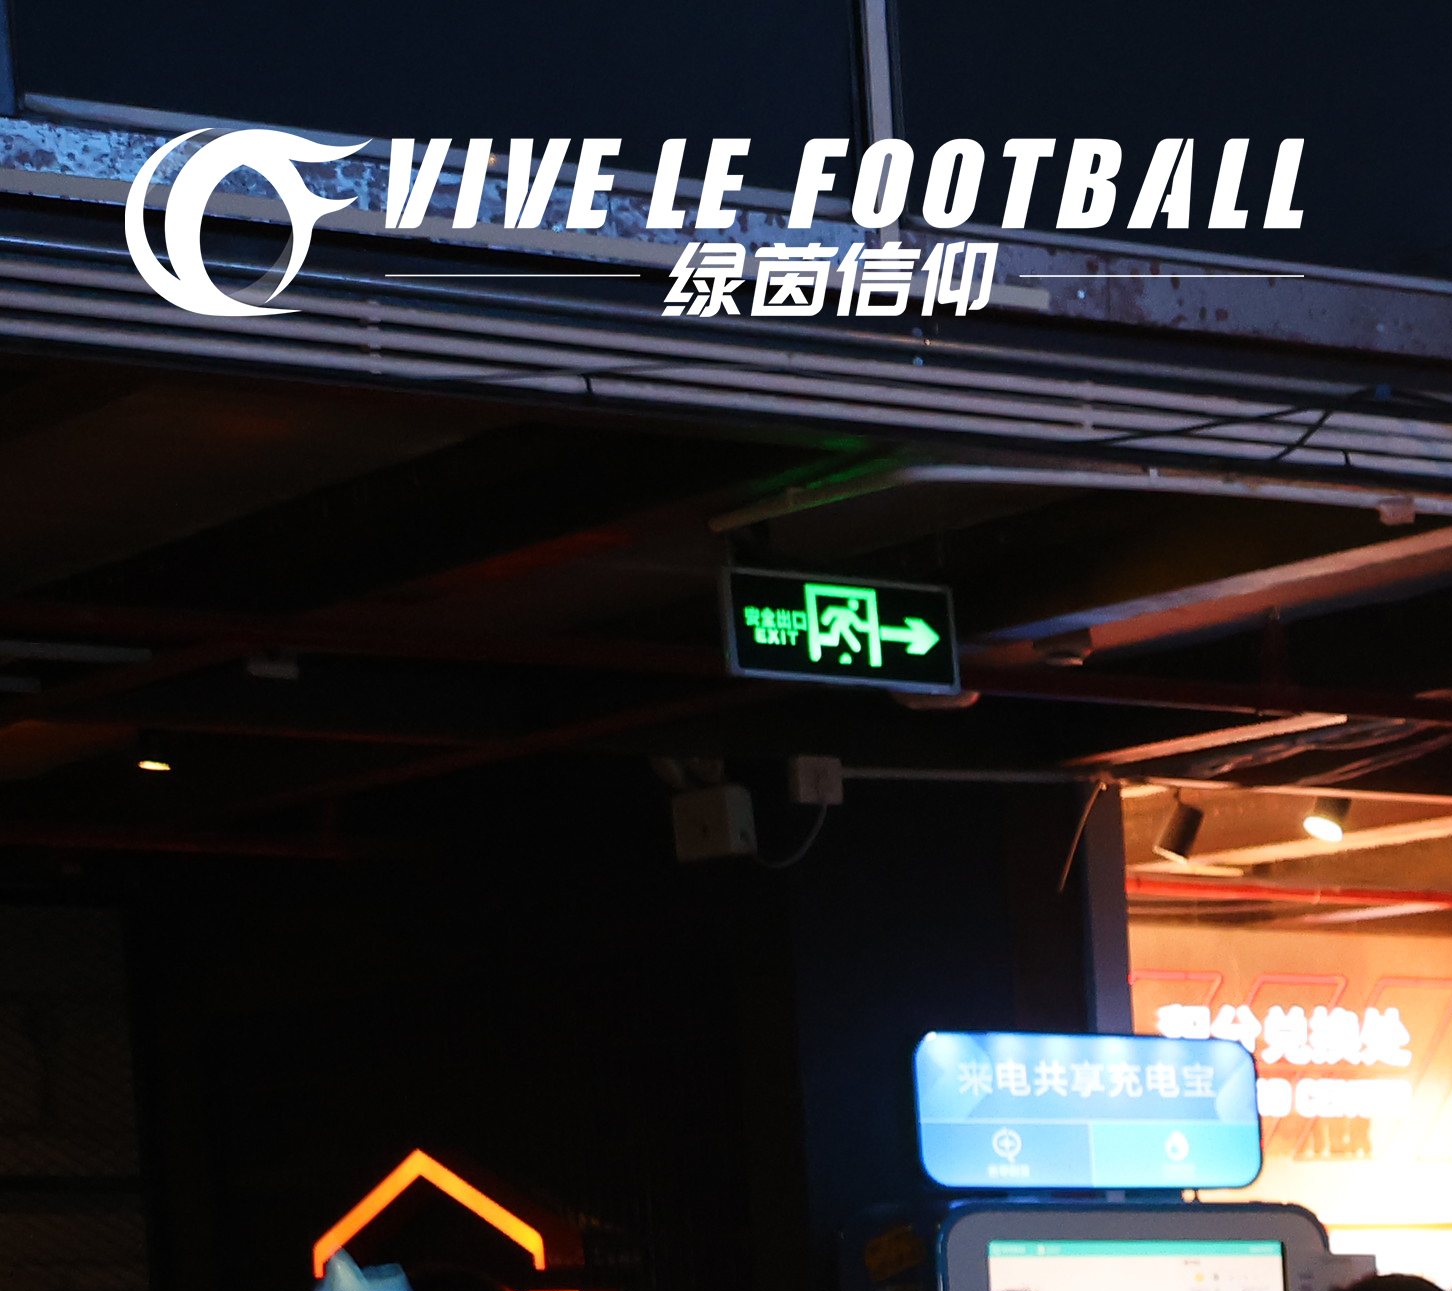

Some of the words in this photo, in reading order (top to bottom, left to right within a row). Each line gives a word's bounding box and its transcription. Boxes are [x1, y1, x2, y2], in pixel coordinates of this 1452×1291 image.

[743, 604, 807, 632] 安全出口
[754, 627, 799, 646] EXIT
[957, 1060, 1216, 1099] 来电共享充电宝
